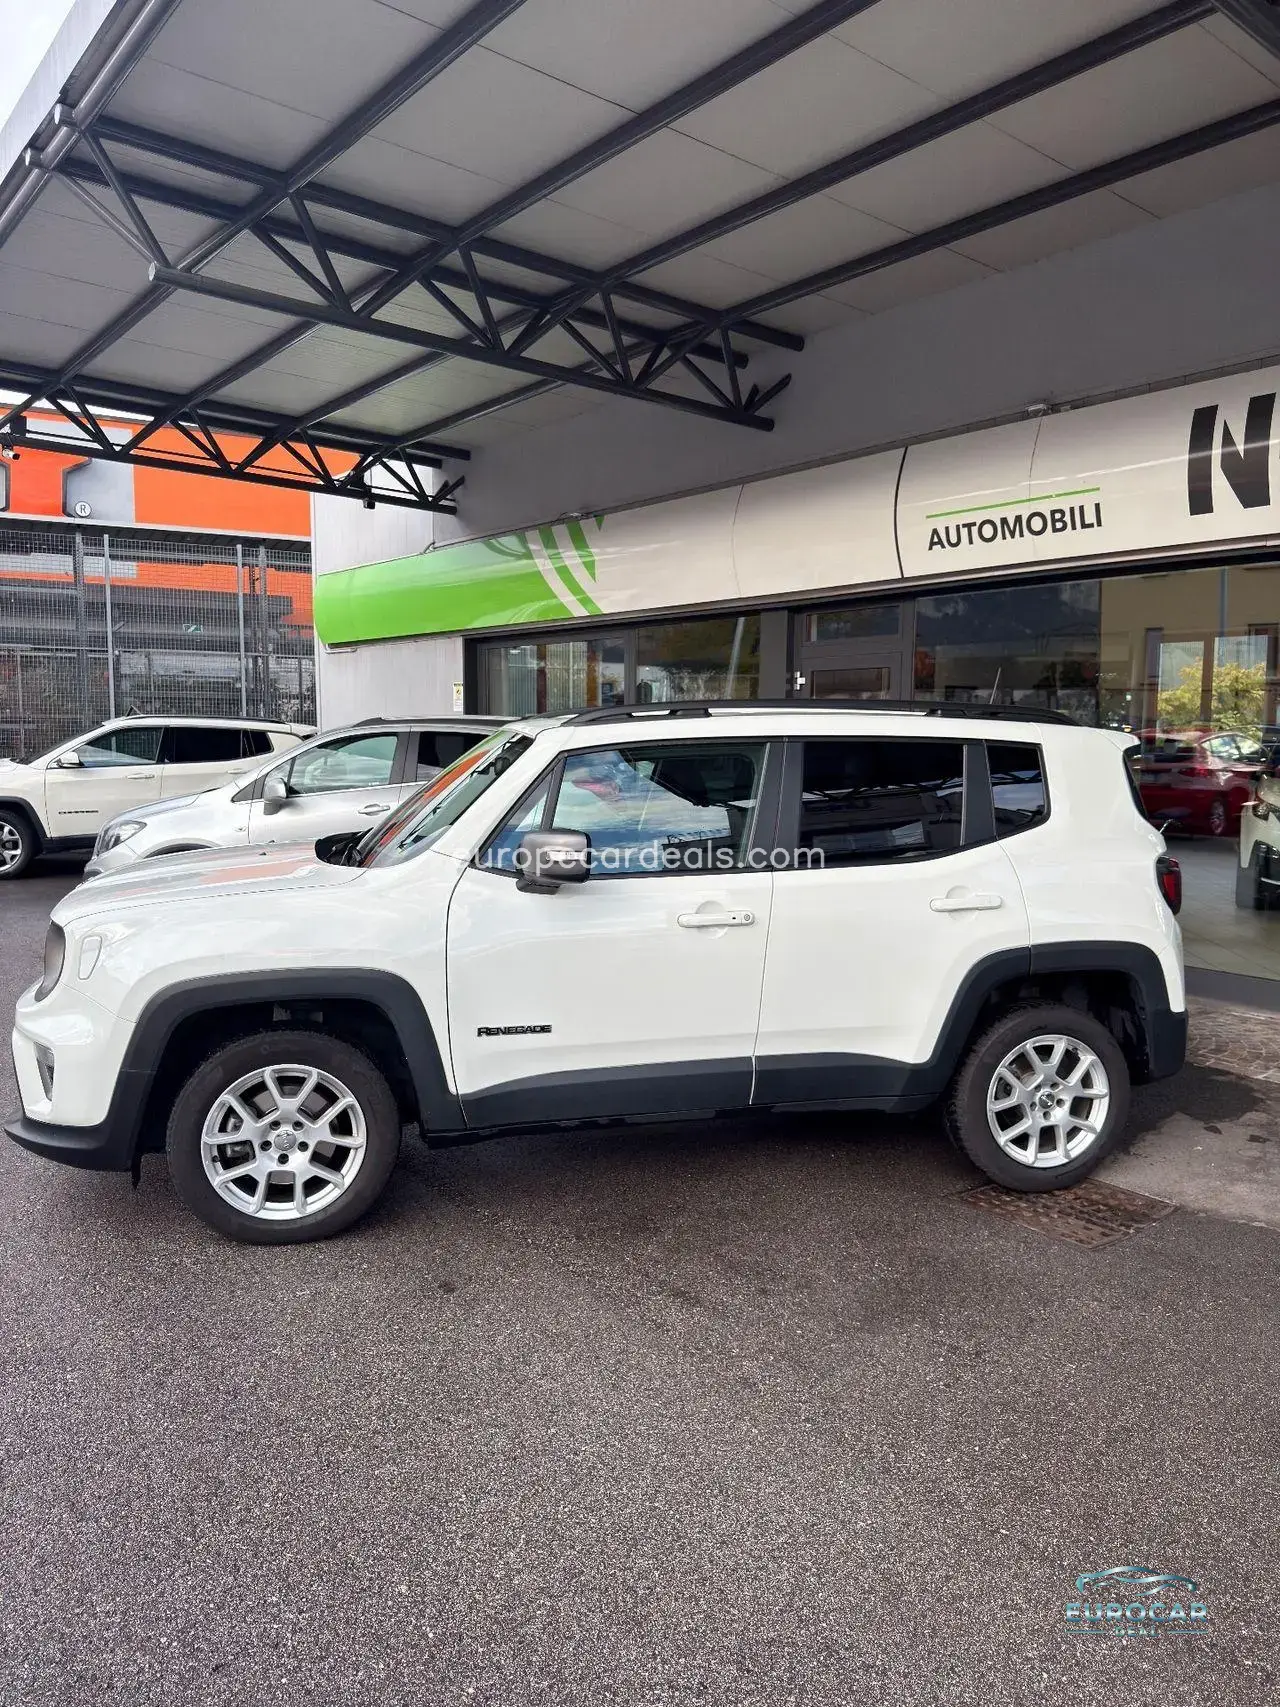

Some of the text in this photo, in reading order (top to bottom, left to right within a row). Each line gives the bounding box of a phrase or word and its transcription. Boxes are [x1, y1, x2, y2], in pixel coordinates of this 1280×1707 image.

[1187, 392, 1280, 516] N
[928, 502, 1102, 551] AUTOMOBILI
[477, 1024, 552, 1037] RENEGADE
